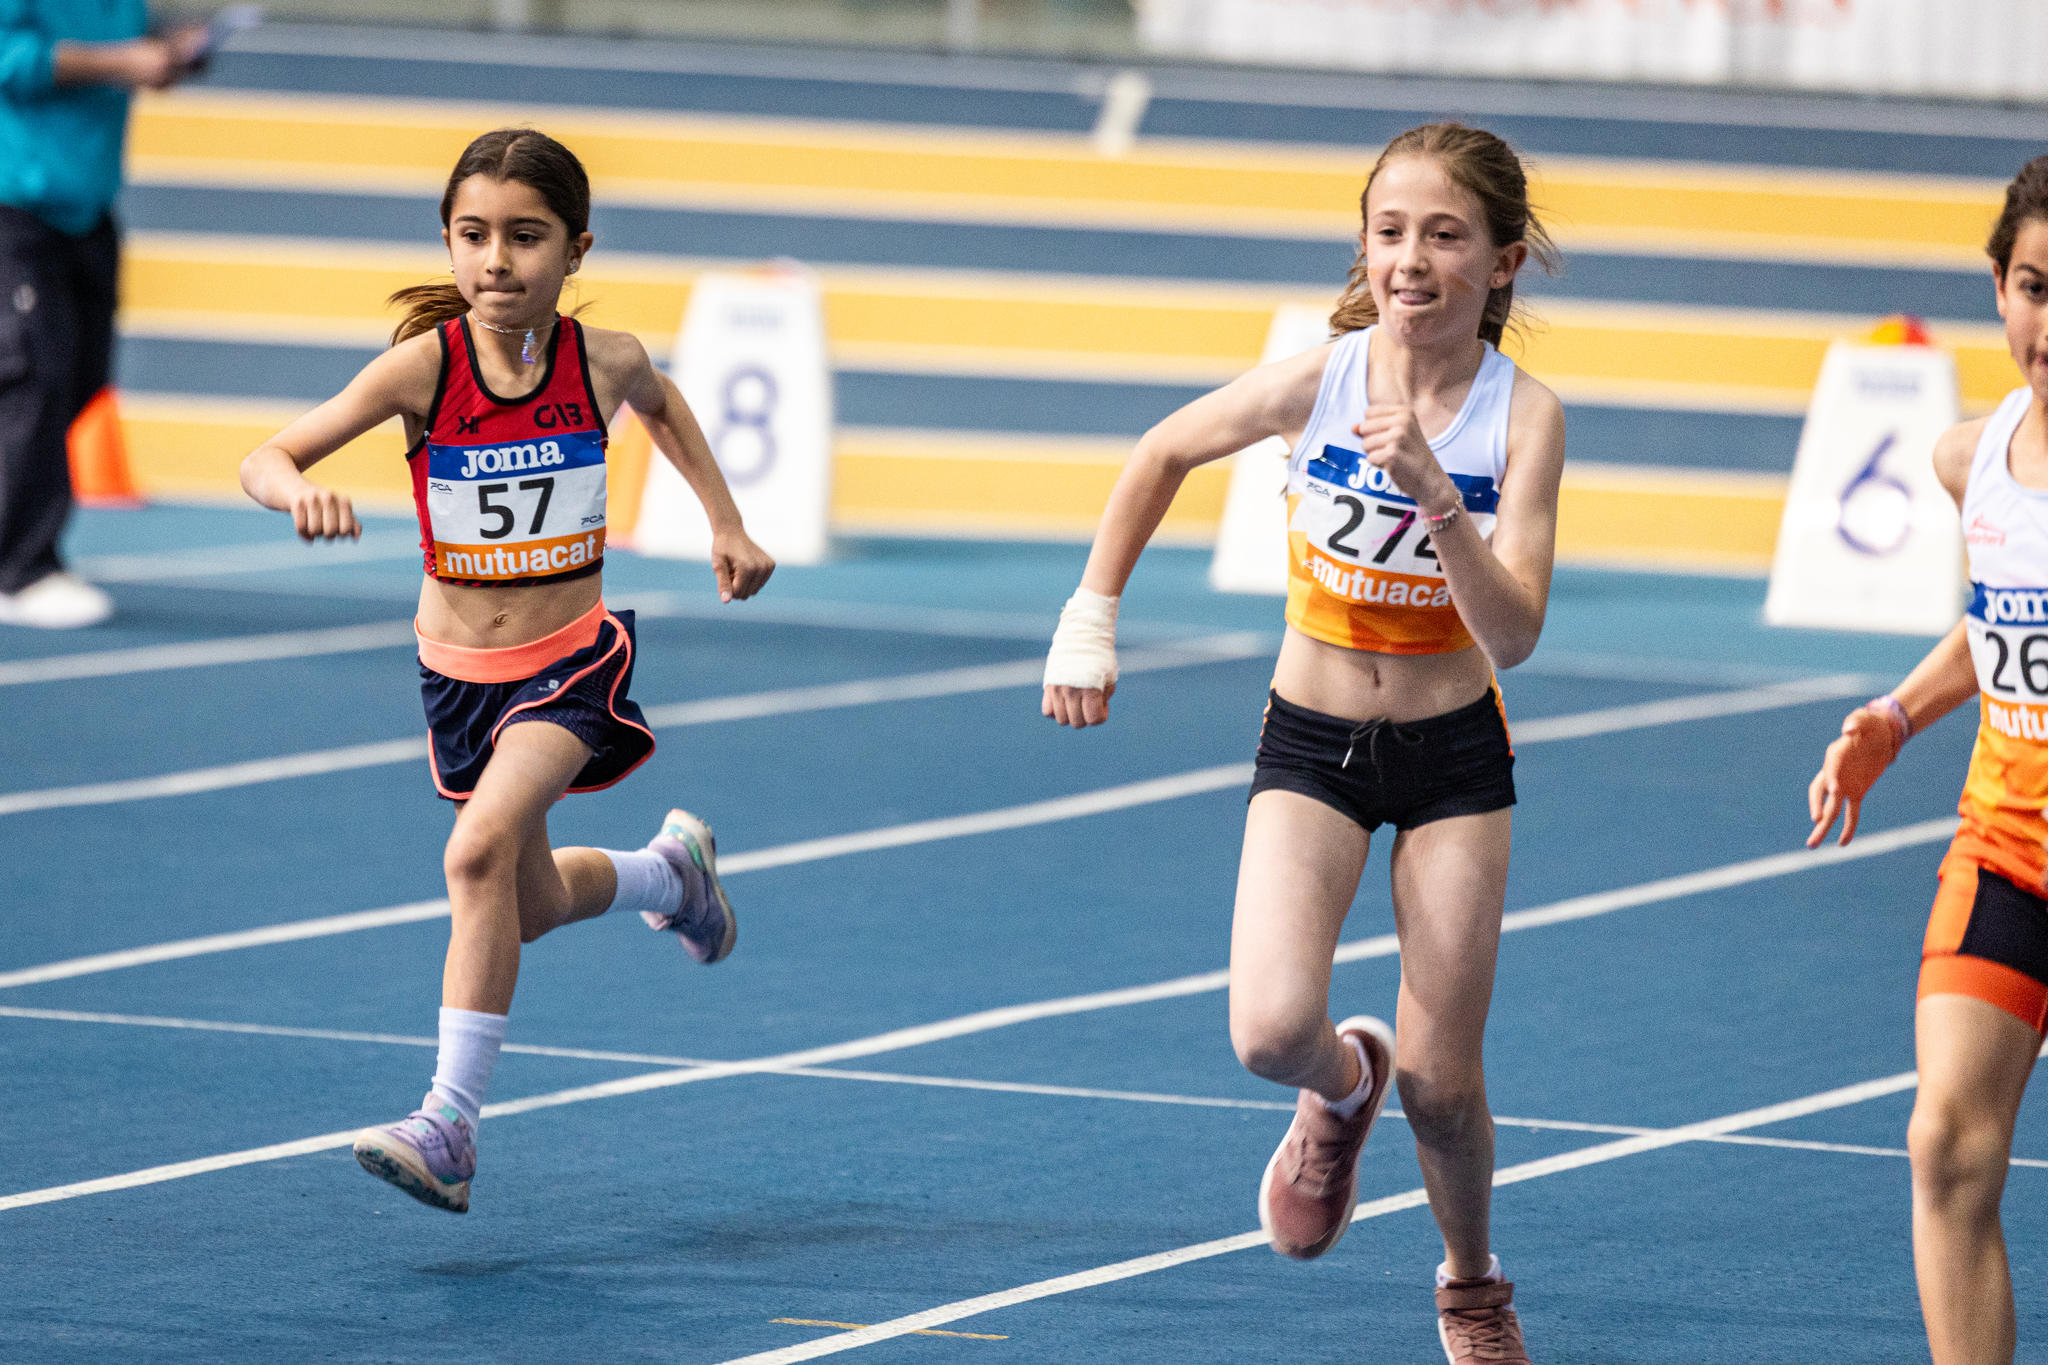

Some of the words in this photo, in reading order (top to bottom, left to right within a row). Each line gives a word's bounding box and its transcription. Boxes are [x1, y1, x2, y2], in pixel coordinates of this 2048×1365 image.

[716, 361, 779, 488] 8
[478, 477, 555, 539] 57
[1836, 427, 1914, 557] 6
[445, 534, 596, 575] mutuacat
[1312, 555, 1456, 607] mutuaca
[1985, 631, 2048, 696] 26
